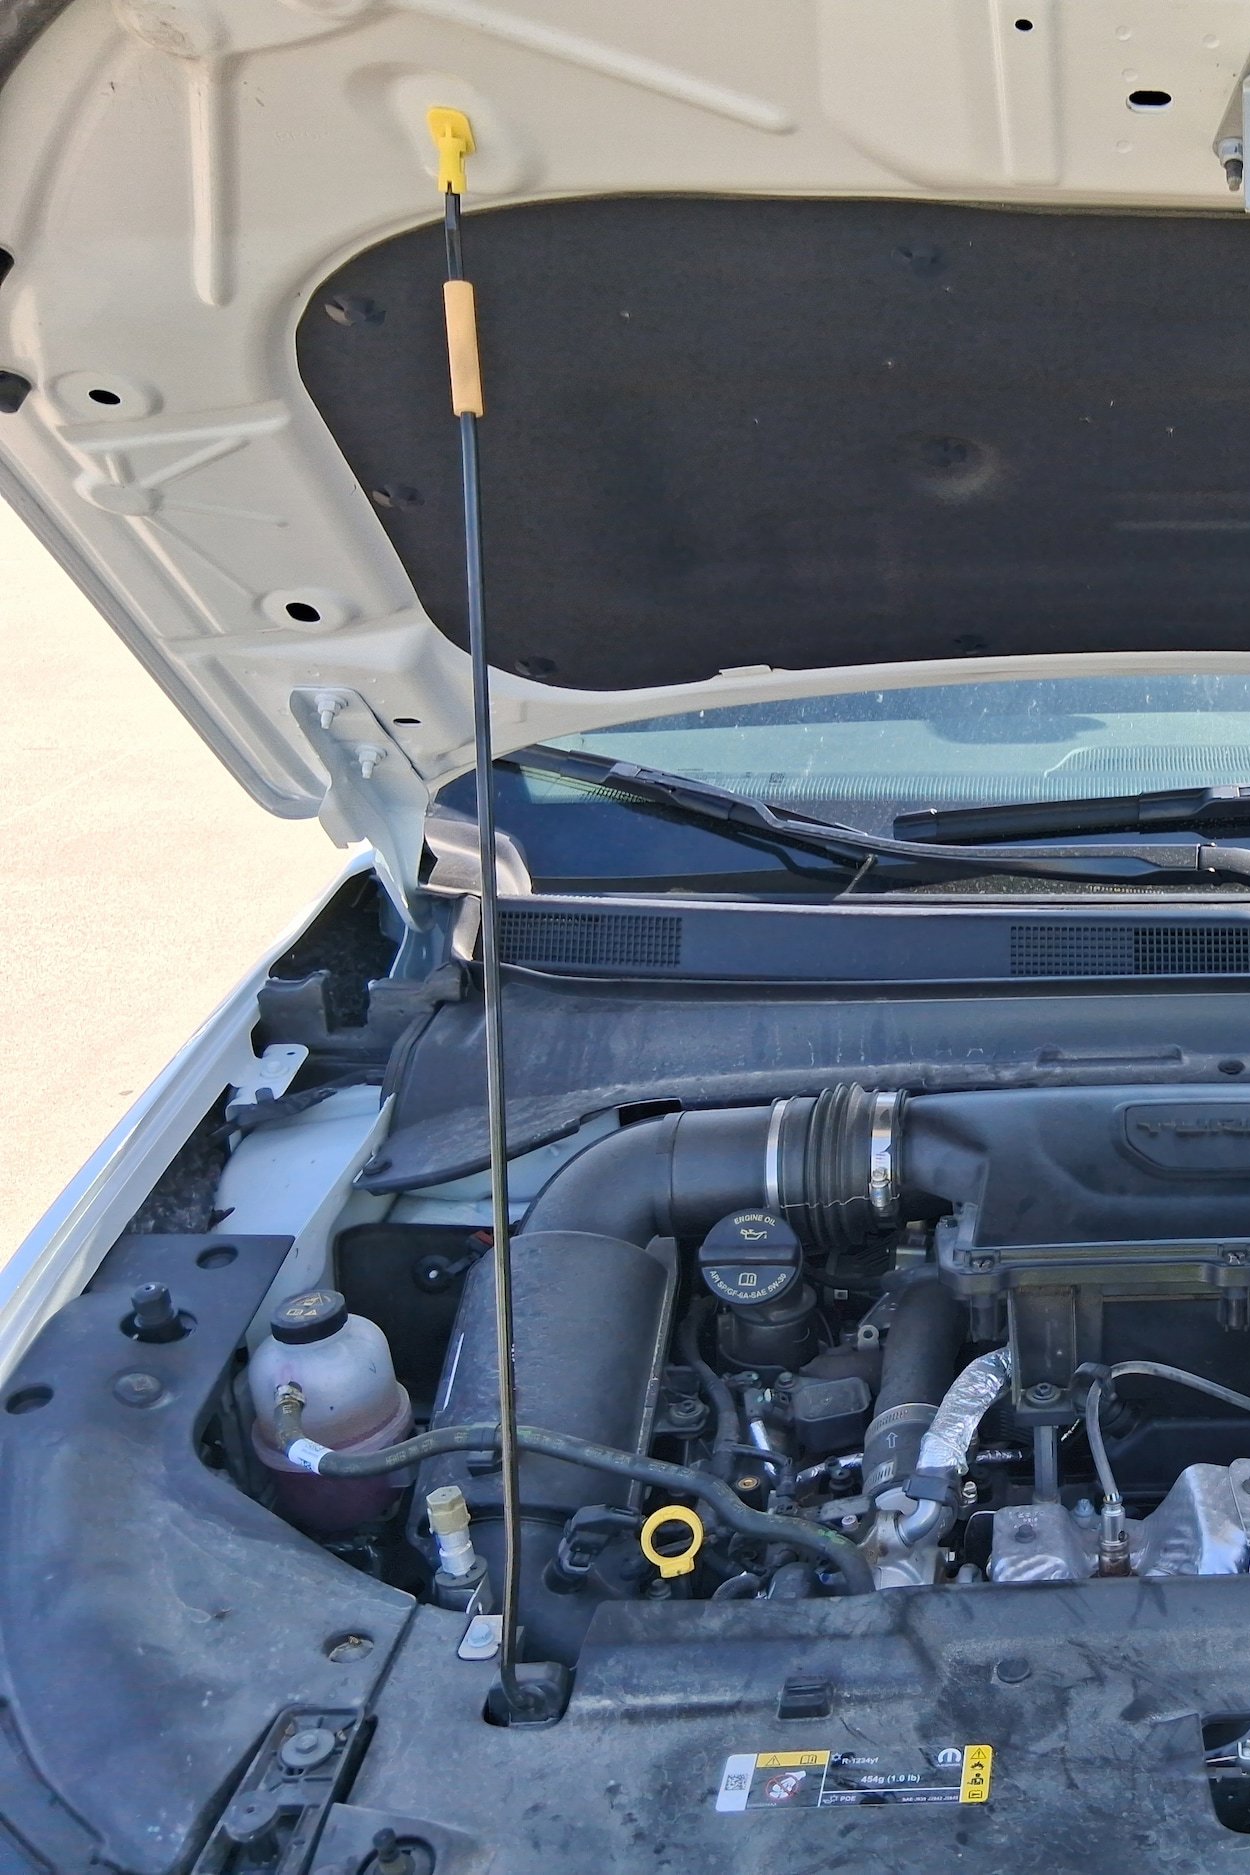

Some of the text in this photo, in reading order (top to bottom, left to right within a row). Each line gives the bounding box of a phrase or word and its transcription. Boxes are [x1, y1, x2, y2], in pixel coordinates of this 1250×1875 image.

[734, 1214, 776, 1226] ENGINE OIL
[709, 1270, 720, 1284] API
[861, 1774, 921, 1784] 454g (1.0 lb)
